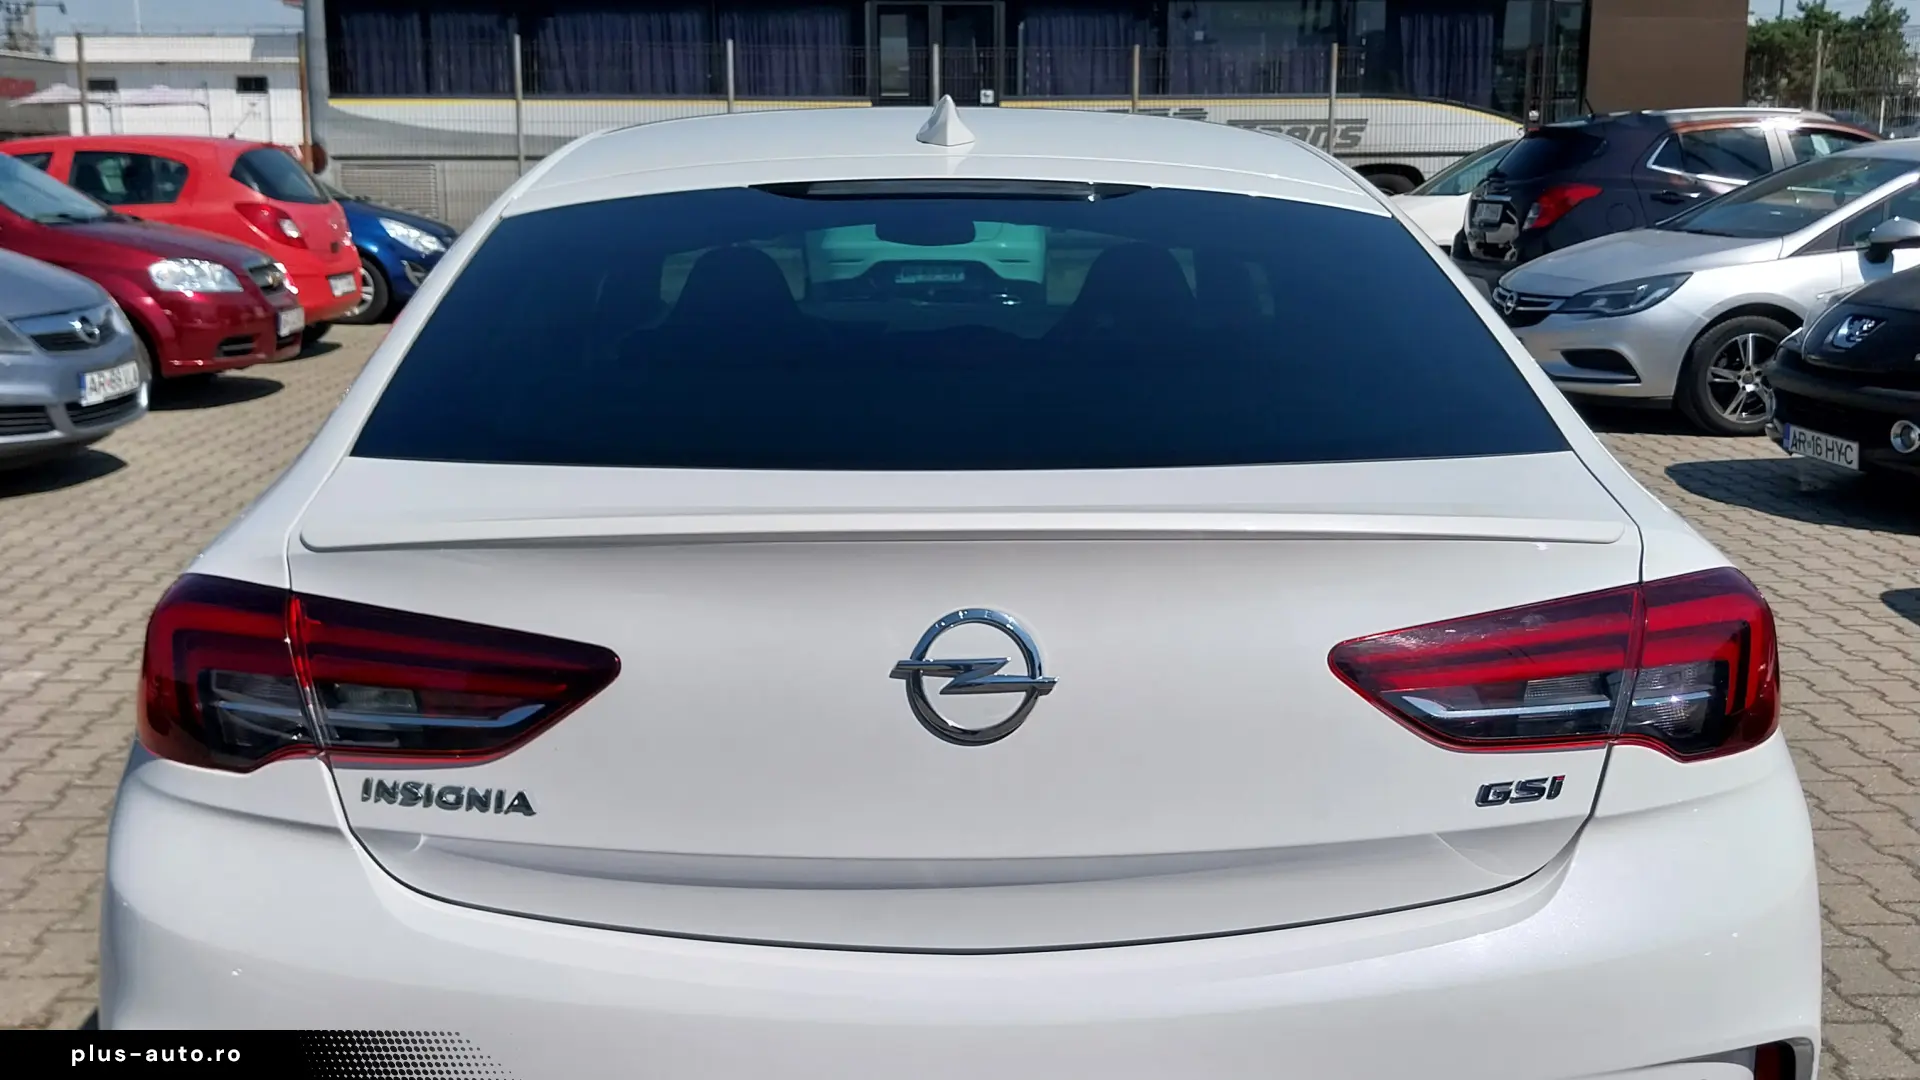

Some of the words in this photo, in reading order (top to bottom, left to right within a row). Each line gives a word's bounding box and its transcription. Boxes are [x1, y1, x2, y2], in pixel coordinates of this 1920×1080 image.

[1227, 118, 1369, 151] ans
[1791, 429, 1807, 452] AR
[1811, 435, 1823, 456] 16
[1825, 438, 1854, 465] HYC
[361, 777, 537, 816] INSIGNIA
